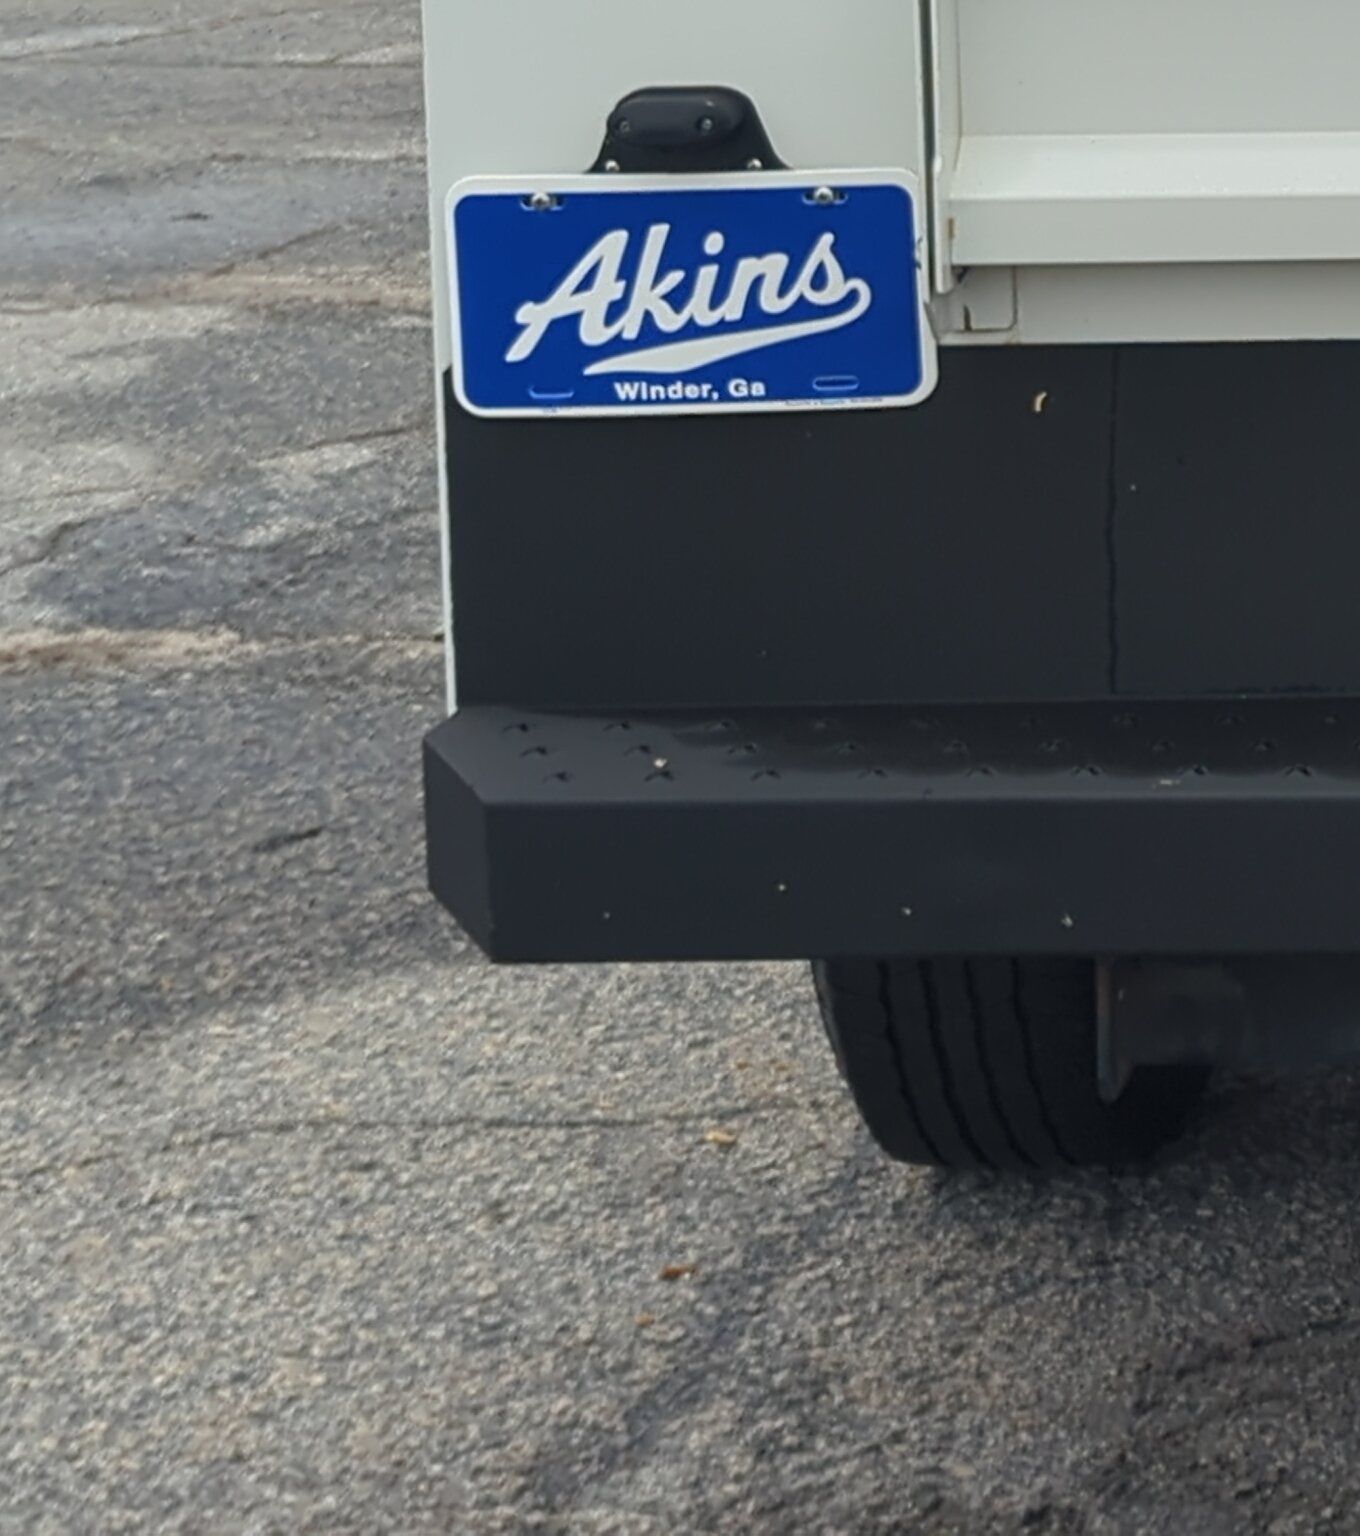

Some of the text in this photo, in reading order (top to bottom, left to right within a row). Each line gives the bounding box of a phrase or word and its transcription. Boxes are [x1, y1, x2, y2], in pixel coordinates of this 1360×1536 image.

[504, 222, 872, 375] Akins
[614, 377, 767, 402] Winder, Ga
